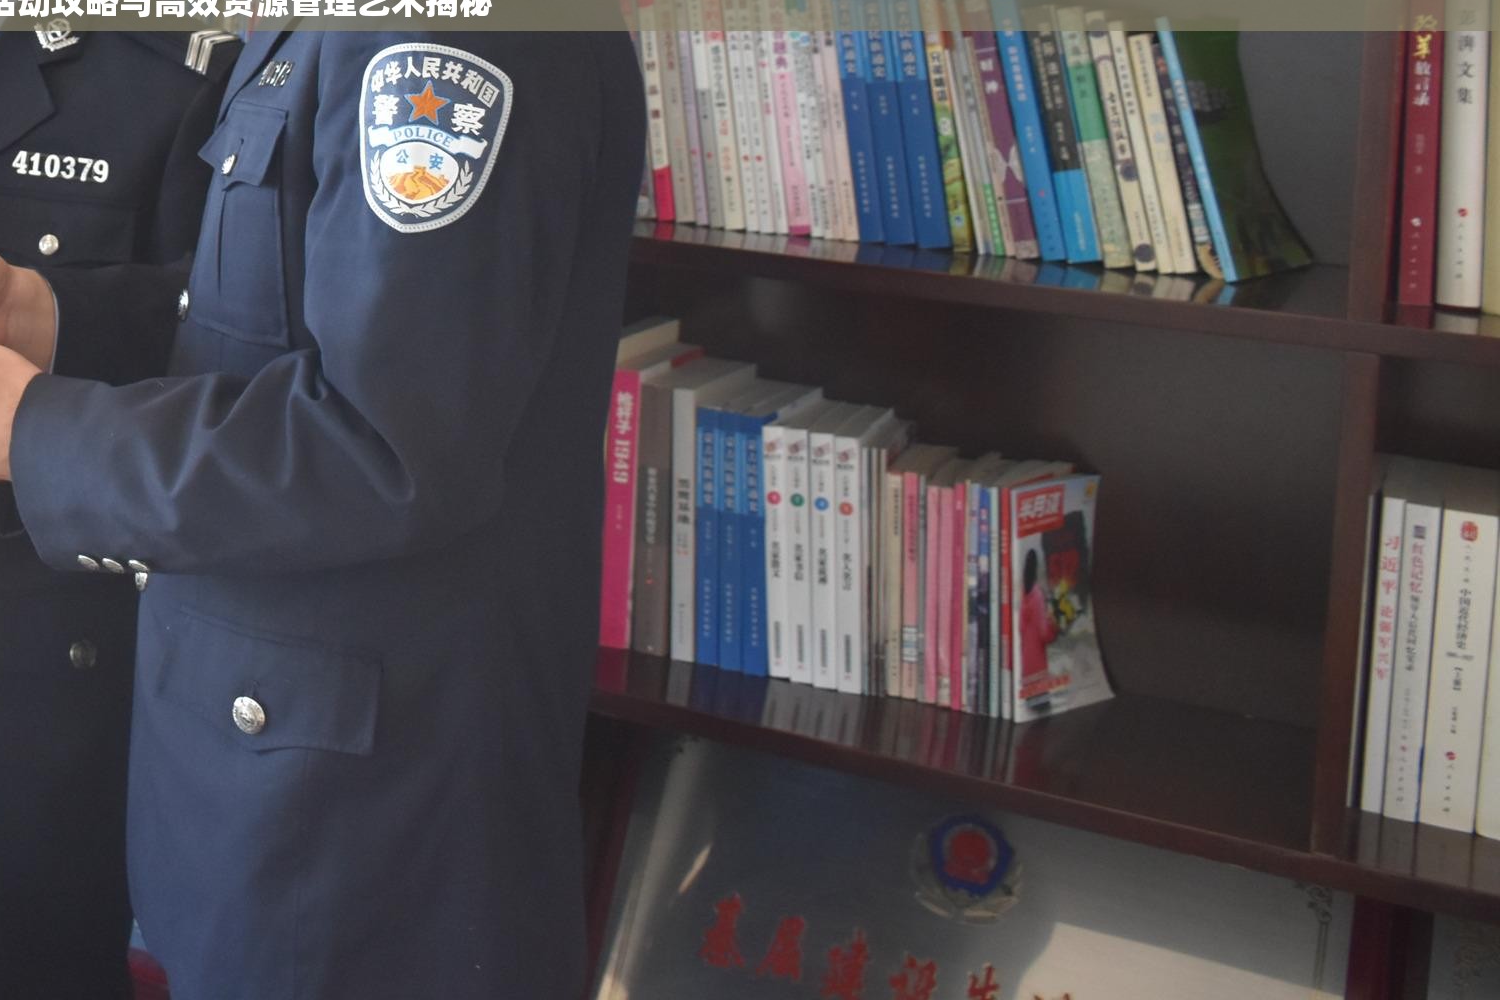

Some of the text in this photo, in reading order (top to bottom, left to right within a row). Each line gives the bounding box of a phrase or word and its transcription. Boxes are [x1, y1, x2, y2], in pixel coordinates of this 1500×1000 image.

[370, 55, 501, 109] 中华人民共和国
[393, 125, 455, 148] POLICE
[11, 150, 110, 183] 410379
